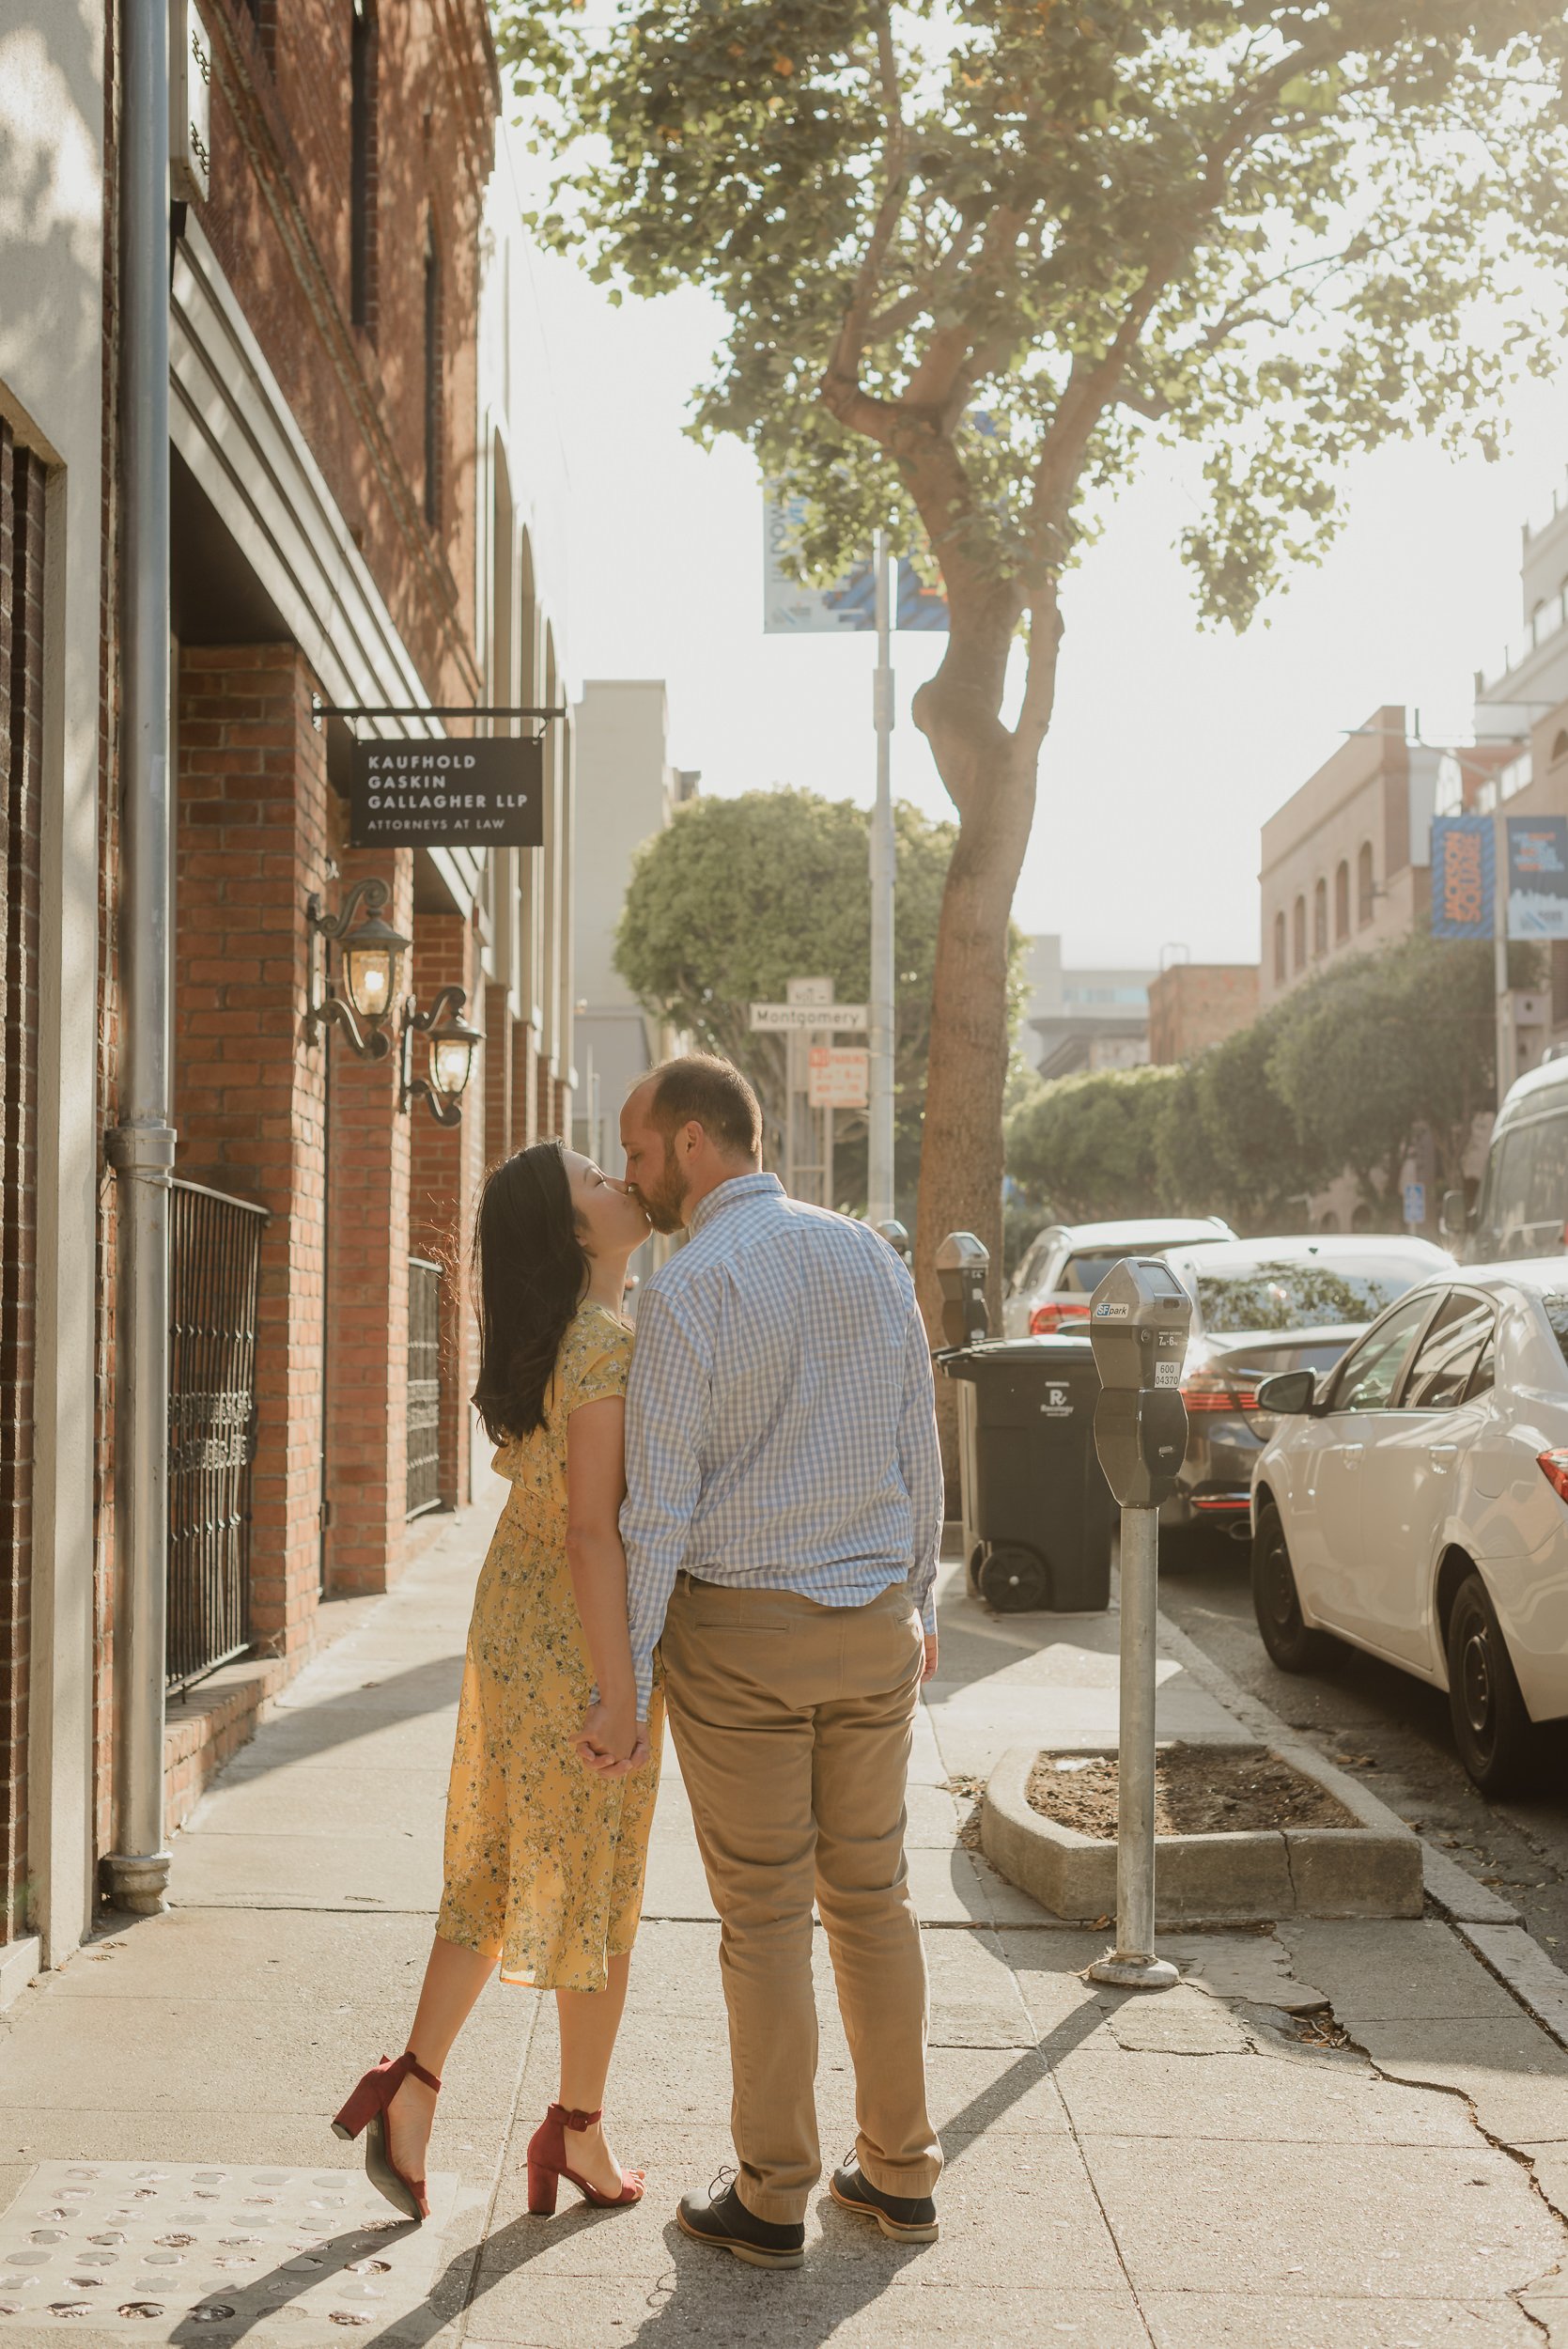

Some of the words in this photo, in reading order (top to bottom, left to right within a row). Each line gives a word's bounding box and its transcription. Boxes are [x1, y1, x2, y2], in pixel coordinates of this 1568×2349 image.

[368, 755, 476, 770] KAUFHOLD
[368, 775, 446, 789] GASKIN
[367, 795, 487, 809] GALLAGHER
[496, 794, 528, 808] LLP
[367, 819, 448, 831] ATTORNEYS
[454, 818, 470, 830] AT
[476, 818, 505, 830] LAW
[756, 1010, 860, 1029] Montgomery
[1160, 1364, 1174, 1374] 600
[1156, 1376, 1179, 1385] 04370
